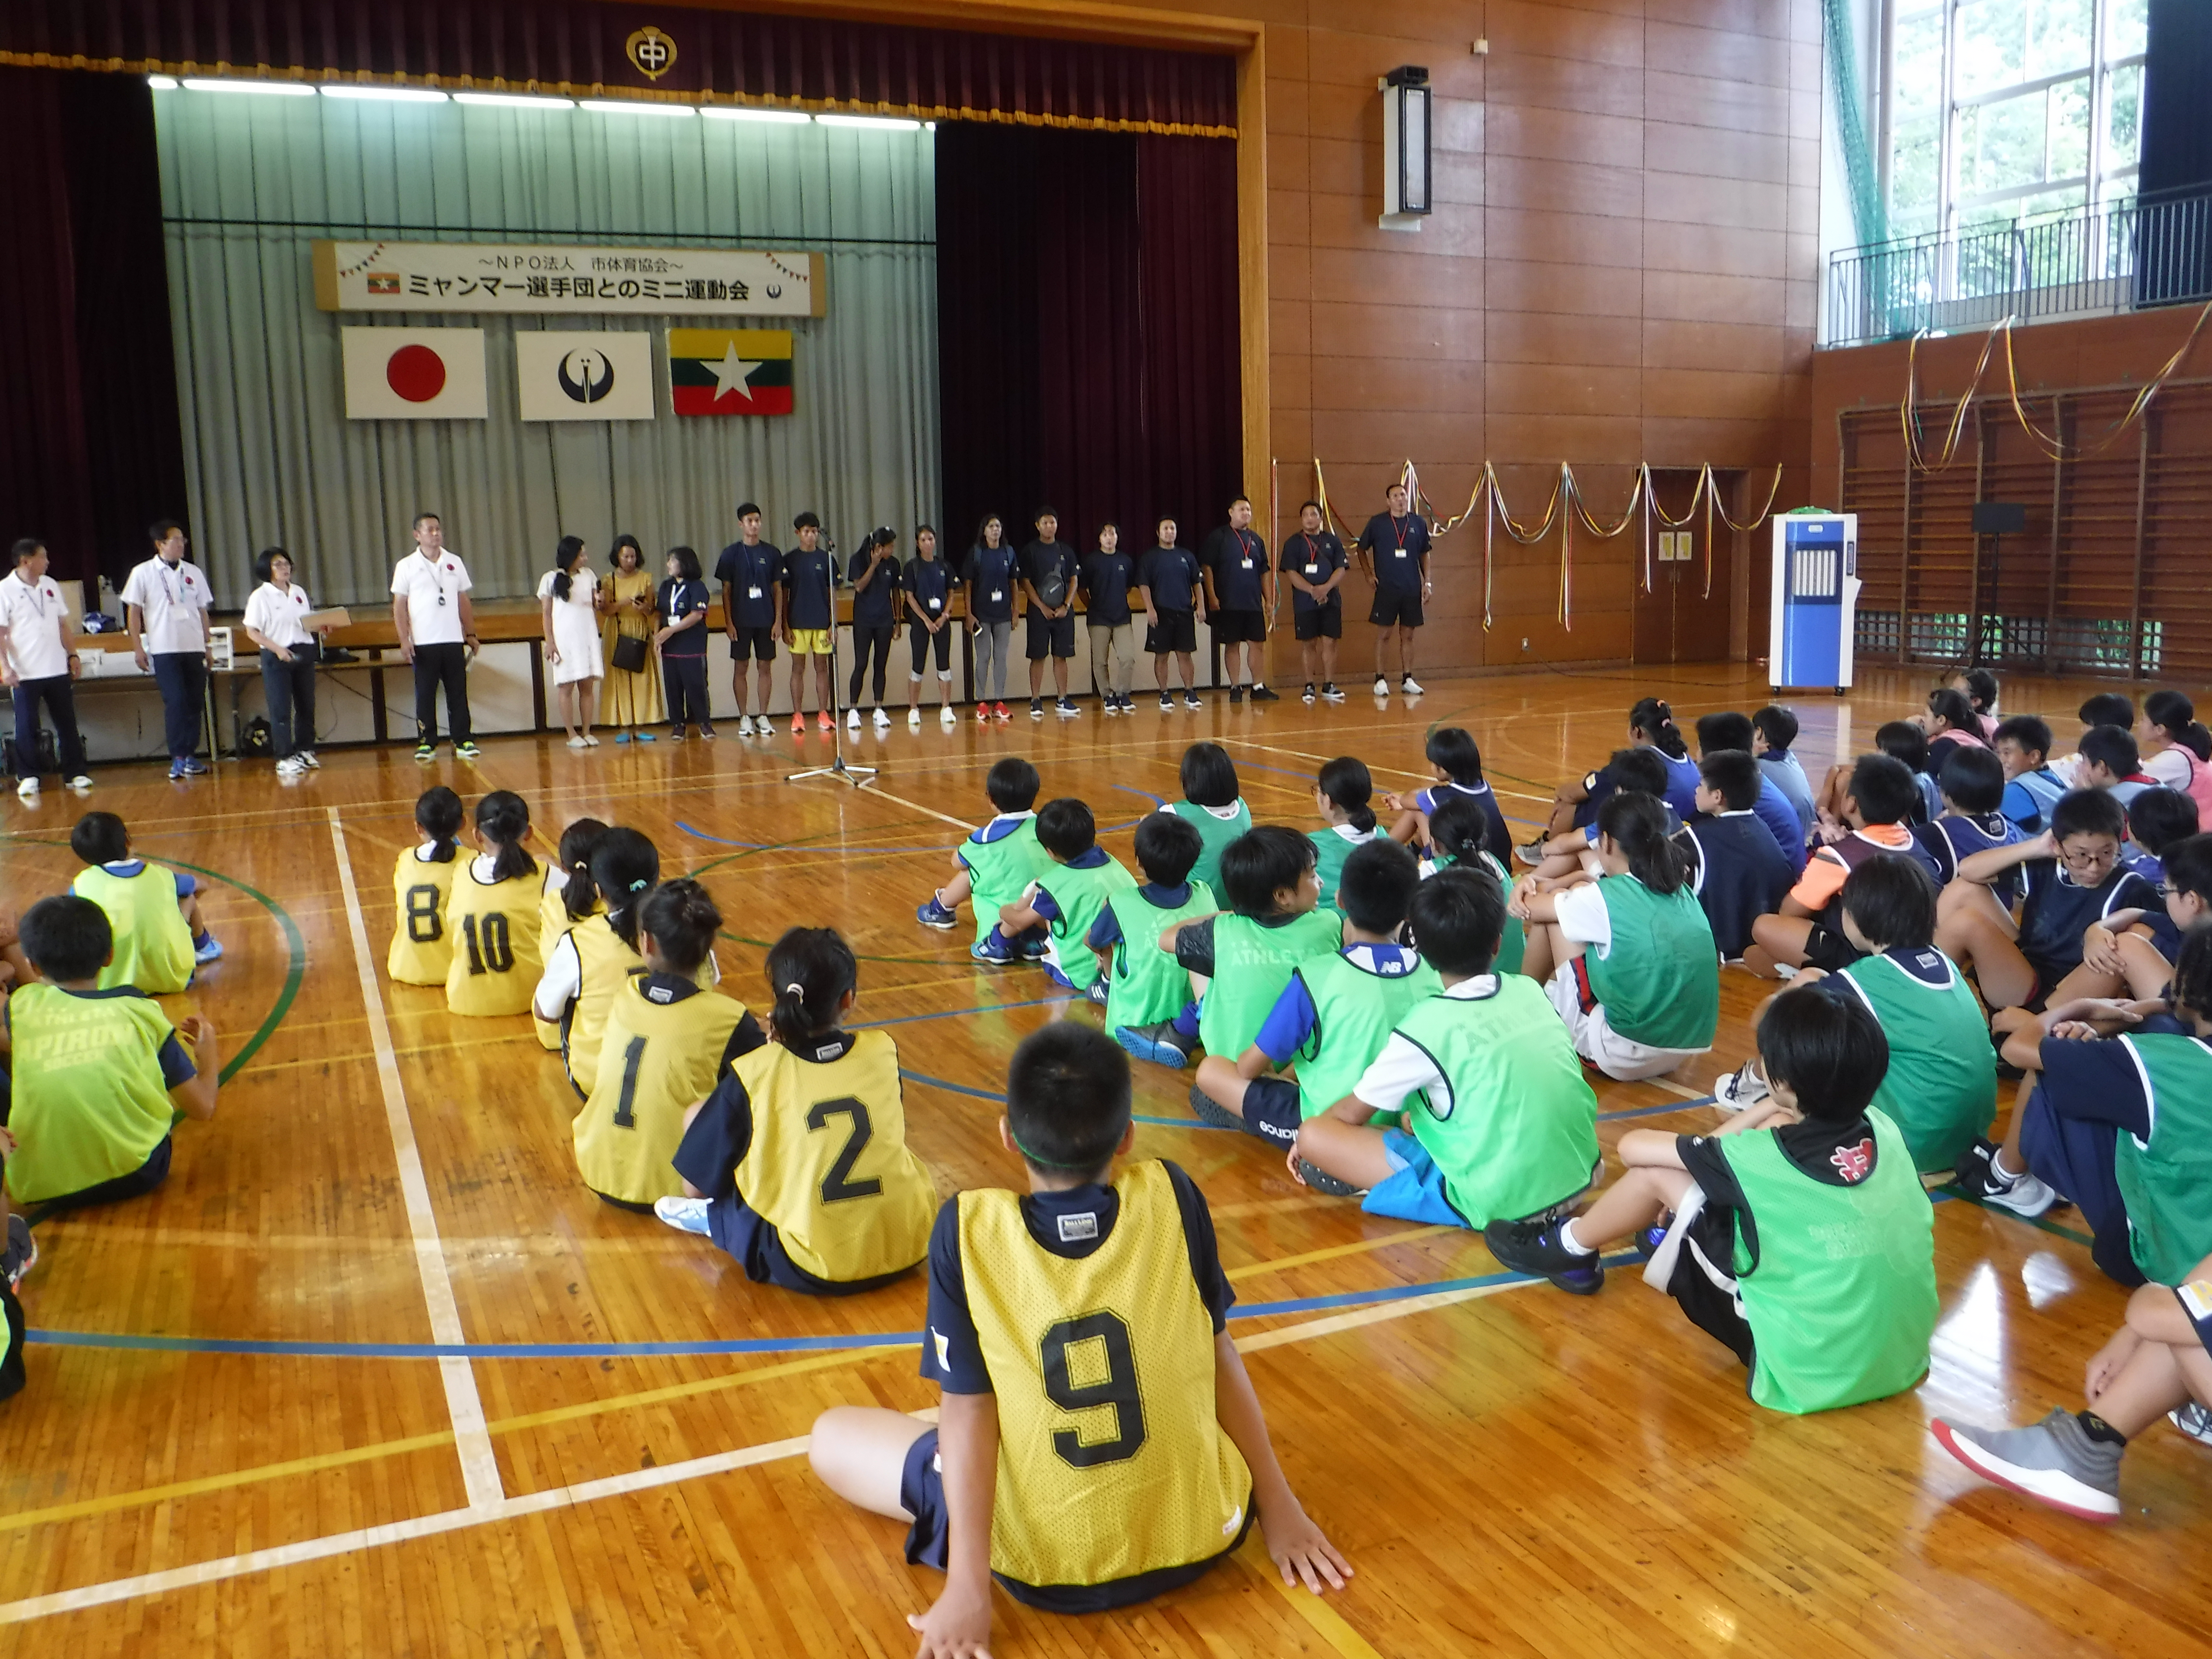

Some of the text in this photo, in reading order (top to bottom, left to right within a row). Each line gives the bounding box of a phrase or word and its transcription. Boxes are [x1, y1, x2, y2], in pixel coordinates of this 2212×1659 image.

[409, 275, 749, 301] ミャンマー選手団とのミニ運動会
[406, 884, 443, 943] 8
[463, 911, 516, 976] 10
[1379, 961, 1402, 974] NB
[612, 1034, 649, 1130] 1
[805, 1094, 884, 1206] 2
[1037, 1306, 1149, 1471] 9
